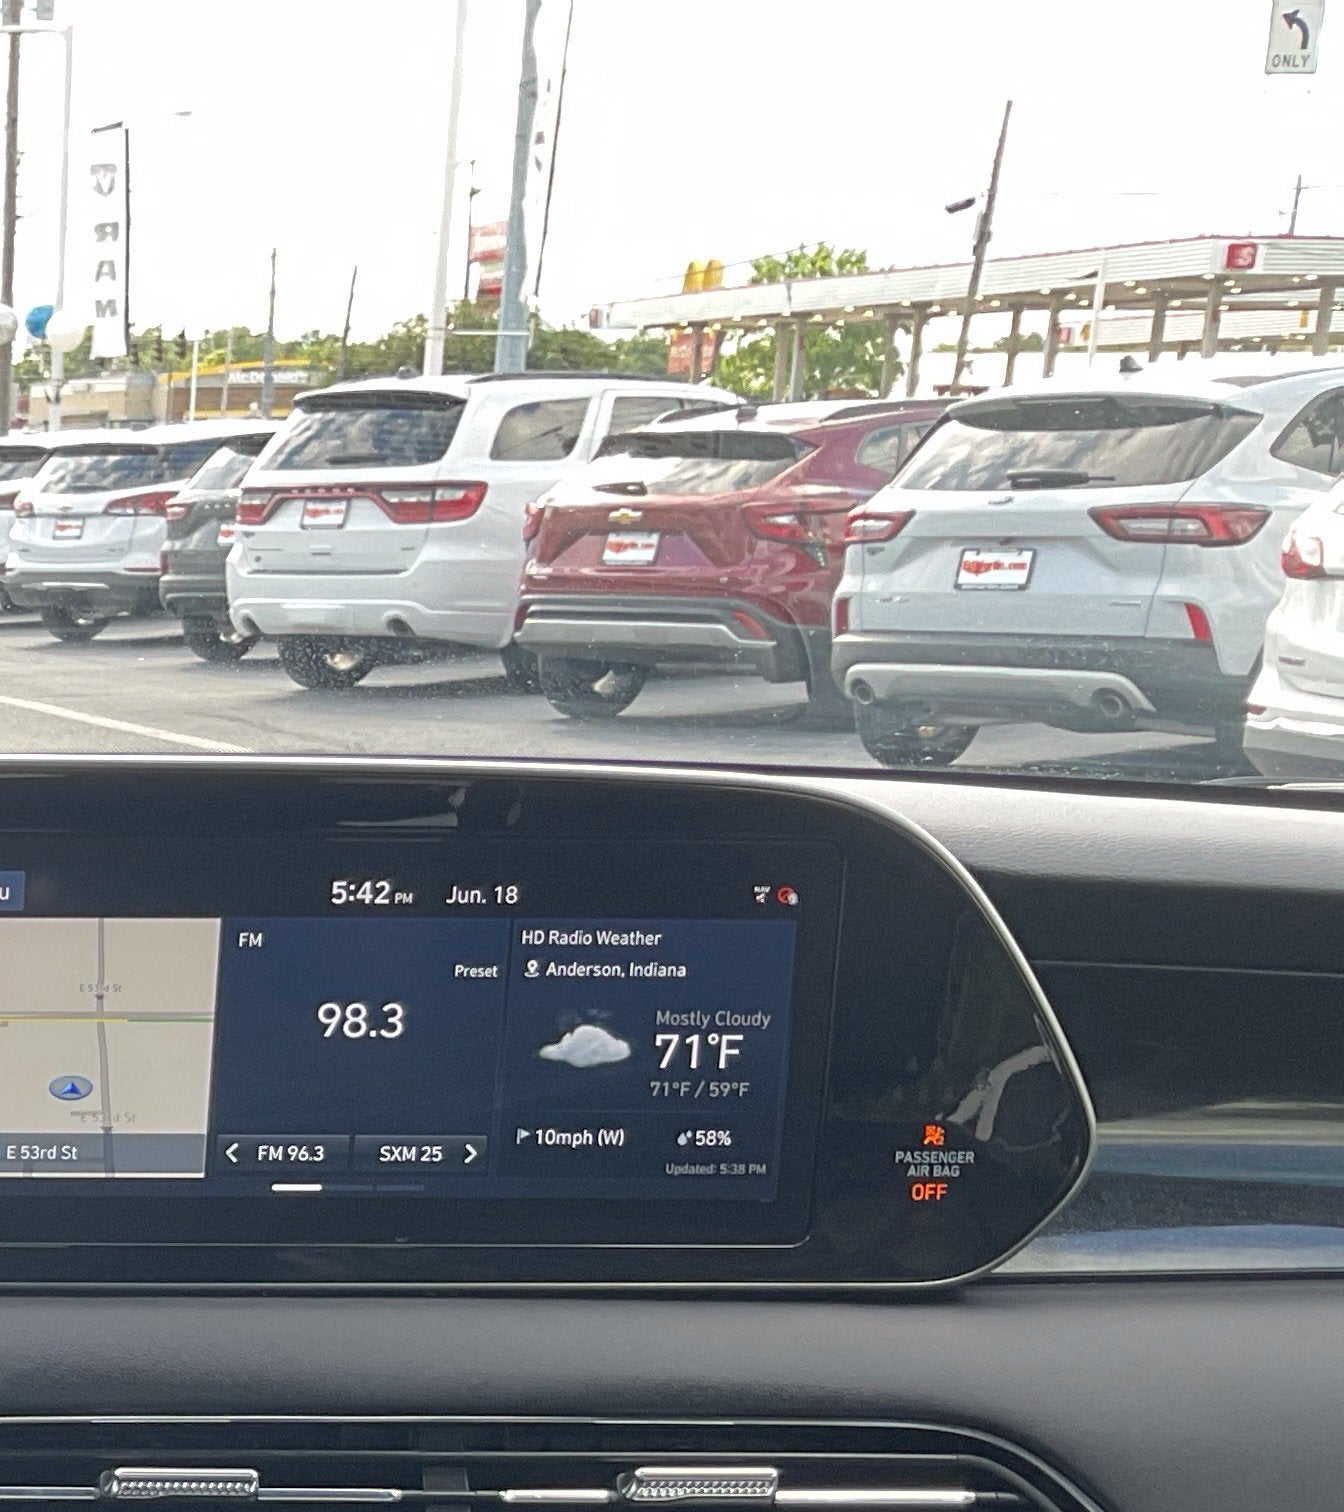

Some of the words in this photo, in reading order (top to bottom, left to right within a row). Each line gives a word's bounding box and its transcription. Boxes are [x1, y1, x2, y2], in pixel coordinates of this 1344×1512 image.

[1271, 54, 1310, 68] ONLY
[330, 880, 392, 905] 5:42
[394, 892, 413, 904] PM
[445, 886, 487, 904] Jun.
[494, 886, 519, 904] 18
[238, 932, 263, 948] FM
[521, 930, 545, 945] HD
[548, 930, 593, 945] Radio
[596, 930, 663, 945] Weather
[454, 964, 499, 978] Preset
[545, 962, 626, 979] Anderson,
[629, 962, 687, 977] Indiana
[317, 1002, 405, 1039] 98.3
[655, 1010, 711, 1030] Mostly
[714, 1010, 772, 1030] Cloudy
[654, 1033, 745, 1070] 71°F
[649, 1081, 692, 1098] 71°F
[708, 1081, 751, 1098] 59°F
[535, 1129, 593, 1148] 10mph
[597, 1129, 625, 1147] (W)
[694, 1129, 732, 1147] 58%
[6, 1145, 16, 1160] E
[20, 1144, 57, 1160] 53rd
[60, 1144, 78, 1160] St
[257, 1145, 283, 1161] FM
[287, 1145, 325, 1162] 96.3
[379, 1146, 416, 1162] SXM
[419, 1146, 443, 1162] 25
[894, 1150, 976, 1164] PASSENGER
[748, 1163, 767, 1175] PM
[906, 1164, 930, 1178] AIR
[932, 1164, 961, 1178] BAG
[911, 1182, 949, 1201] OFF
